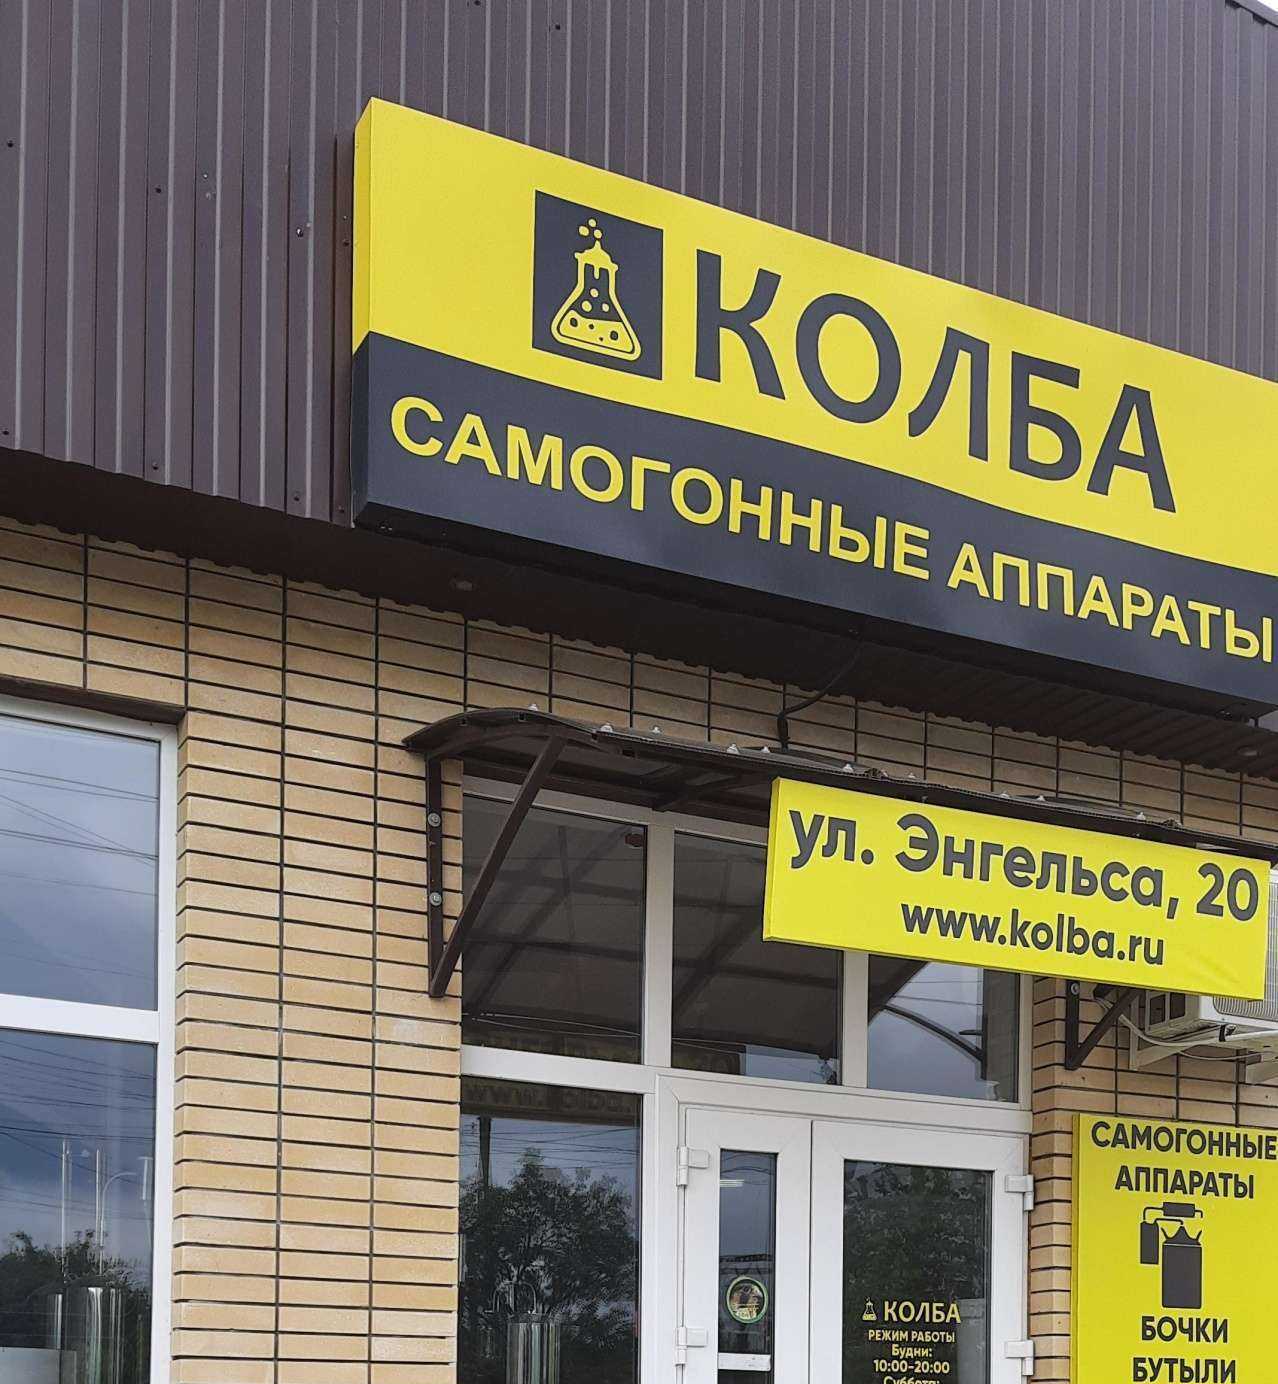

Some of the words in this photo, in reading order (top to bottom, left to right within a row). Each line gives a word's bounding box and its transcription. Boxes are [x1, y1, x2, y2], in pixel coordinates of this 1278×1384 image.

[693, 248, 1178, 514] КОЛБА
[390, 396, 931, 580] САМОГОННЫЕ
[947, 544, 1273, 664] АППАРАТЫ
[788, 809, 875, 869] ул.
[895, 813, 1179, 921] Энгельса,
[1196, 862, 1259, 922] 20
[901, 903, 1165, 966] www.kolba.ru
[1090, 1120, 1278, 1161] САМОГОННЫЕ
[1114, 1164, 1255, 1200] АППАРАТЫ
[884, 1300, 962, 1324] КОЛБА
[868, 1329, 908, 1342] РЕЖИМ
[911, 1331, 955, 1343] РАБОТЫ
[1141, 1315, 1228, 1344] БОЧКИ
[873, 1359, 950, 1374] 10:00-20:00
[891, 1343, 933, 1359] Будни:
[1132, 1356, 1236, 1384] БУТЫЛИ
